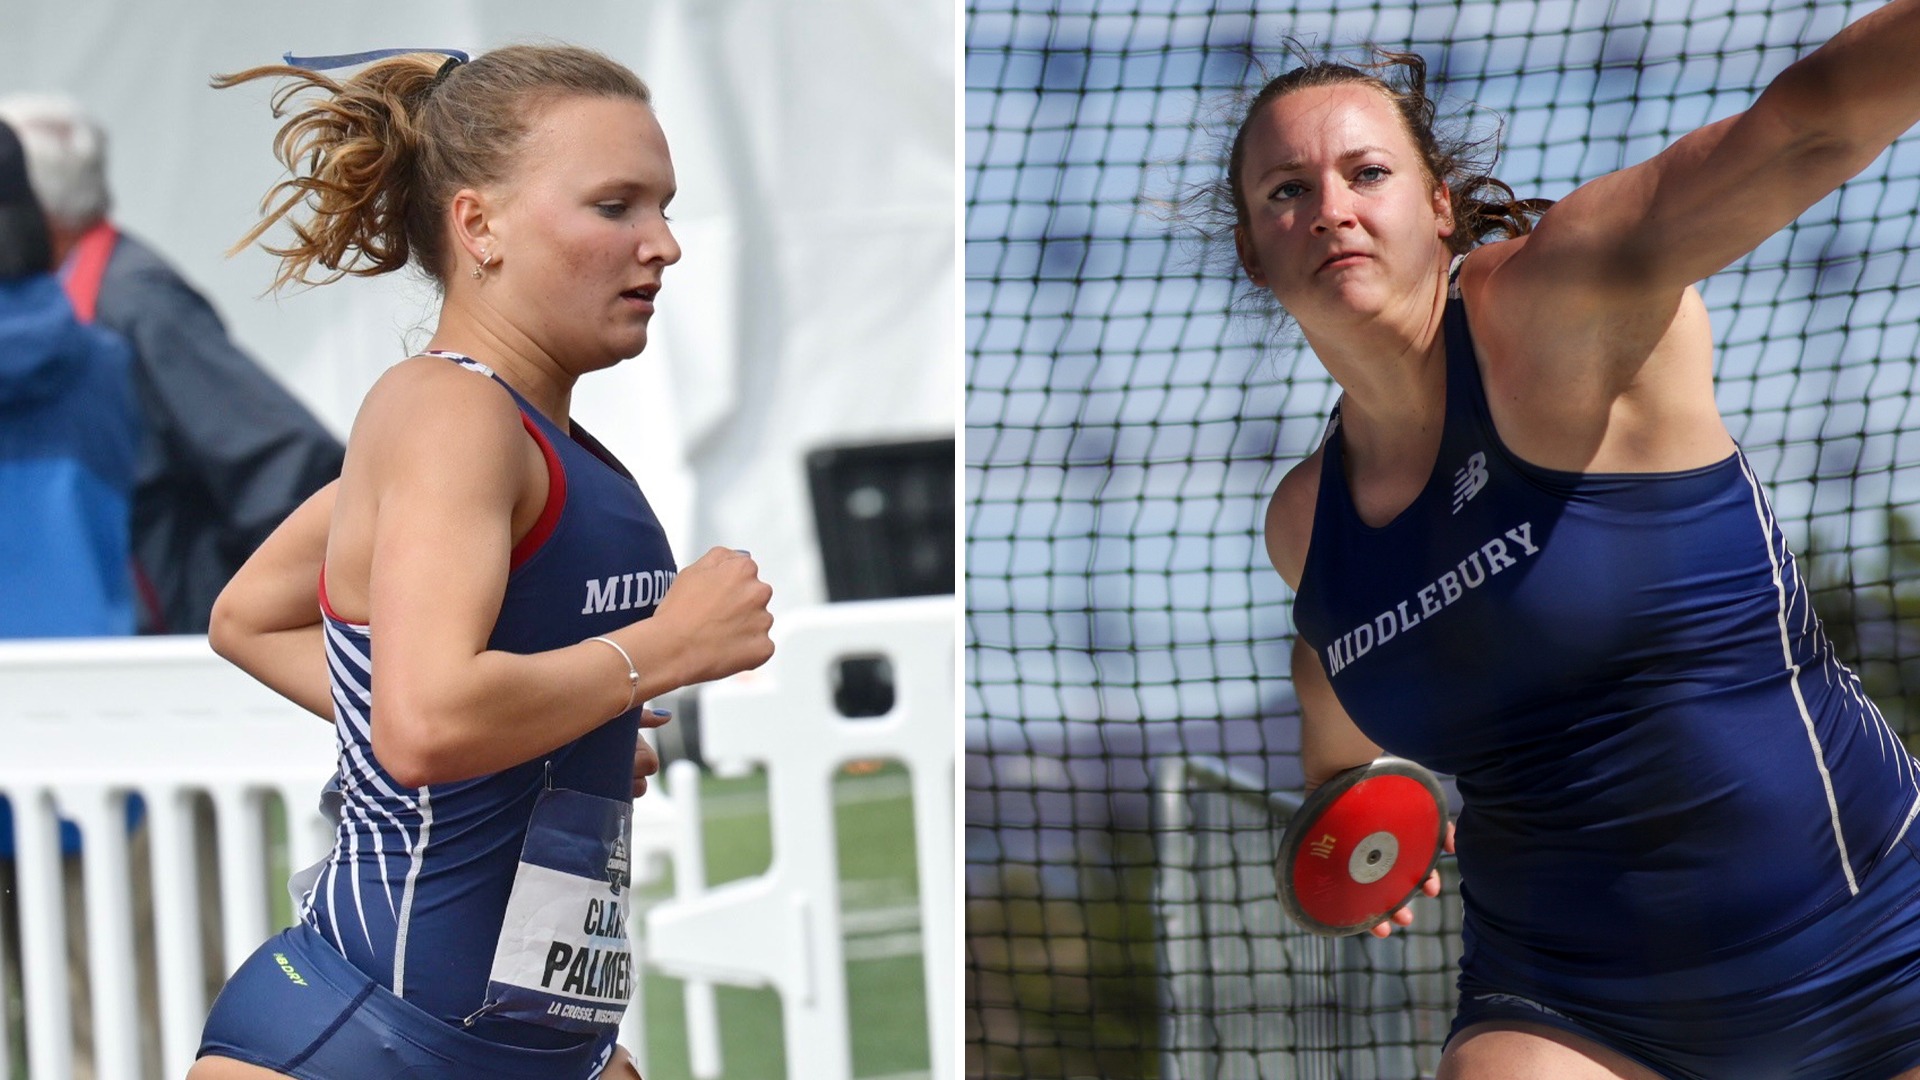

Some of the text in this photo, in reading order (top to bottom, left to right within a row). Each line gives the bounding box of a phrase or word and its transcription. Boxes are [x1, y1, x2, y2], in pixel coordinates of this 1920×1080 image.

[581, 570, 677, 615] MIDD
[1327, 521, 1539, 677] MIDDLEBURY
[547, 1001, 562, 1016] LA
